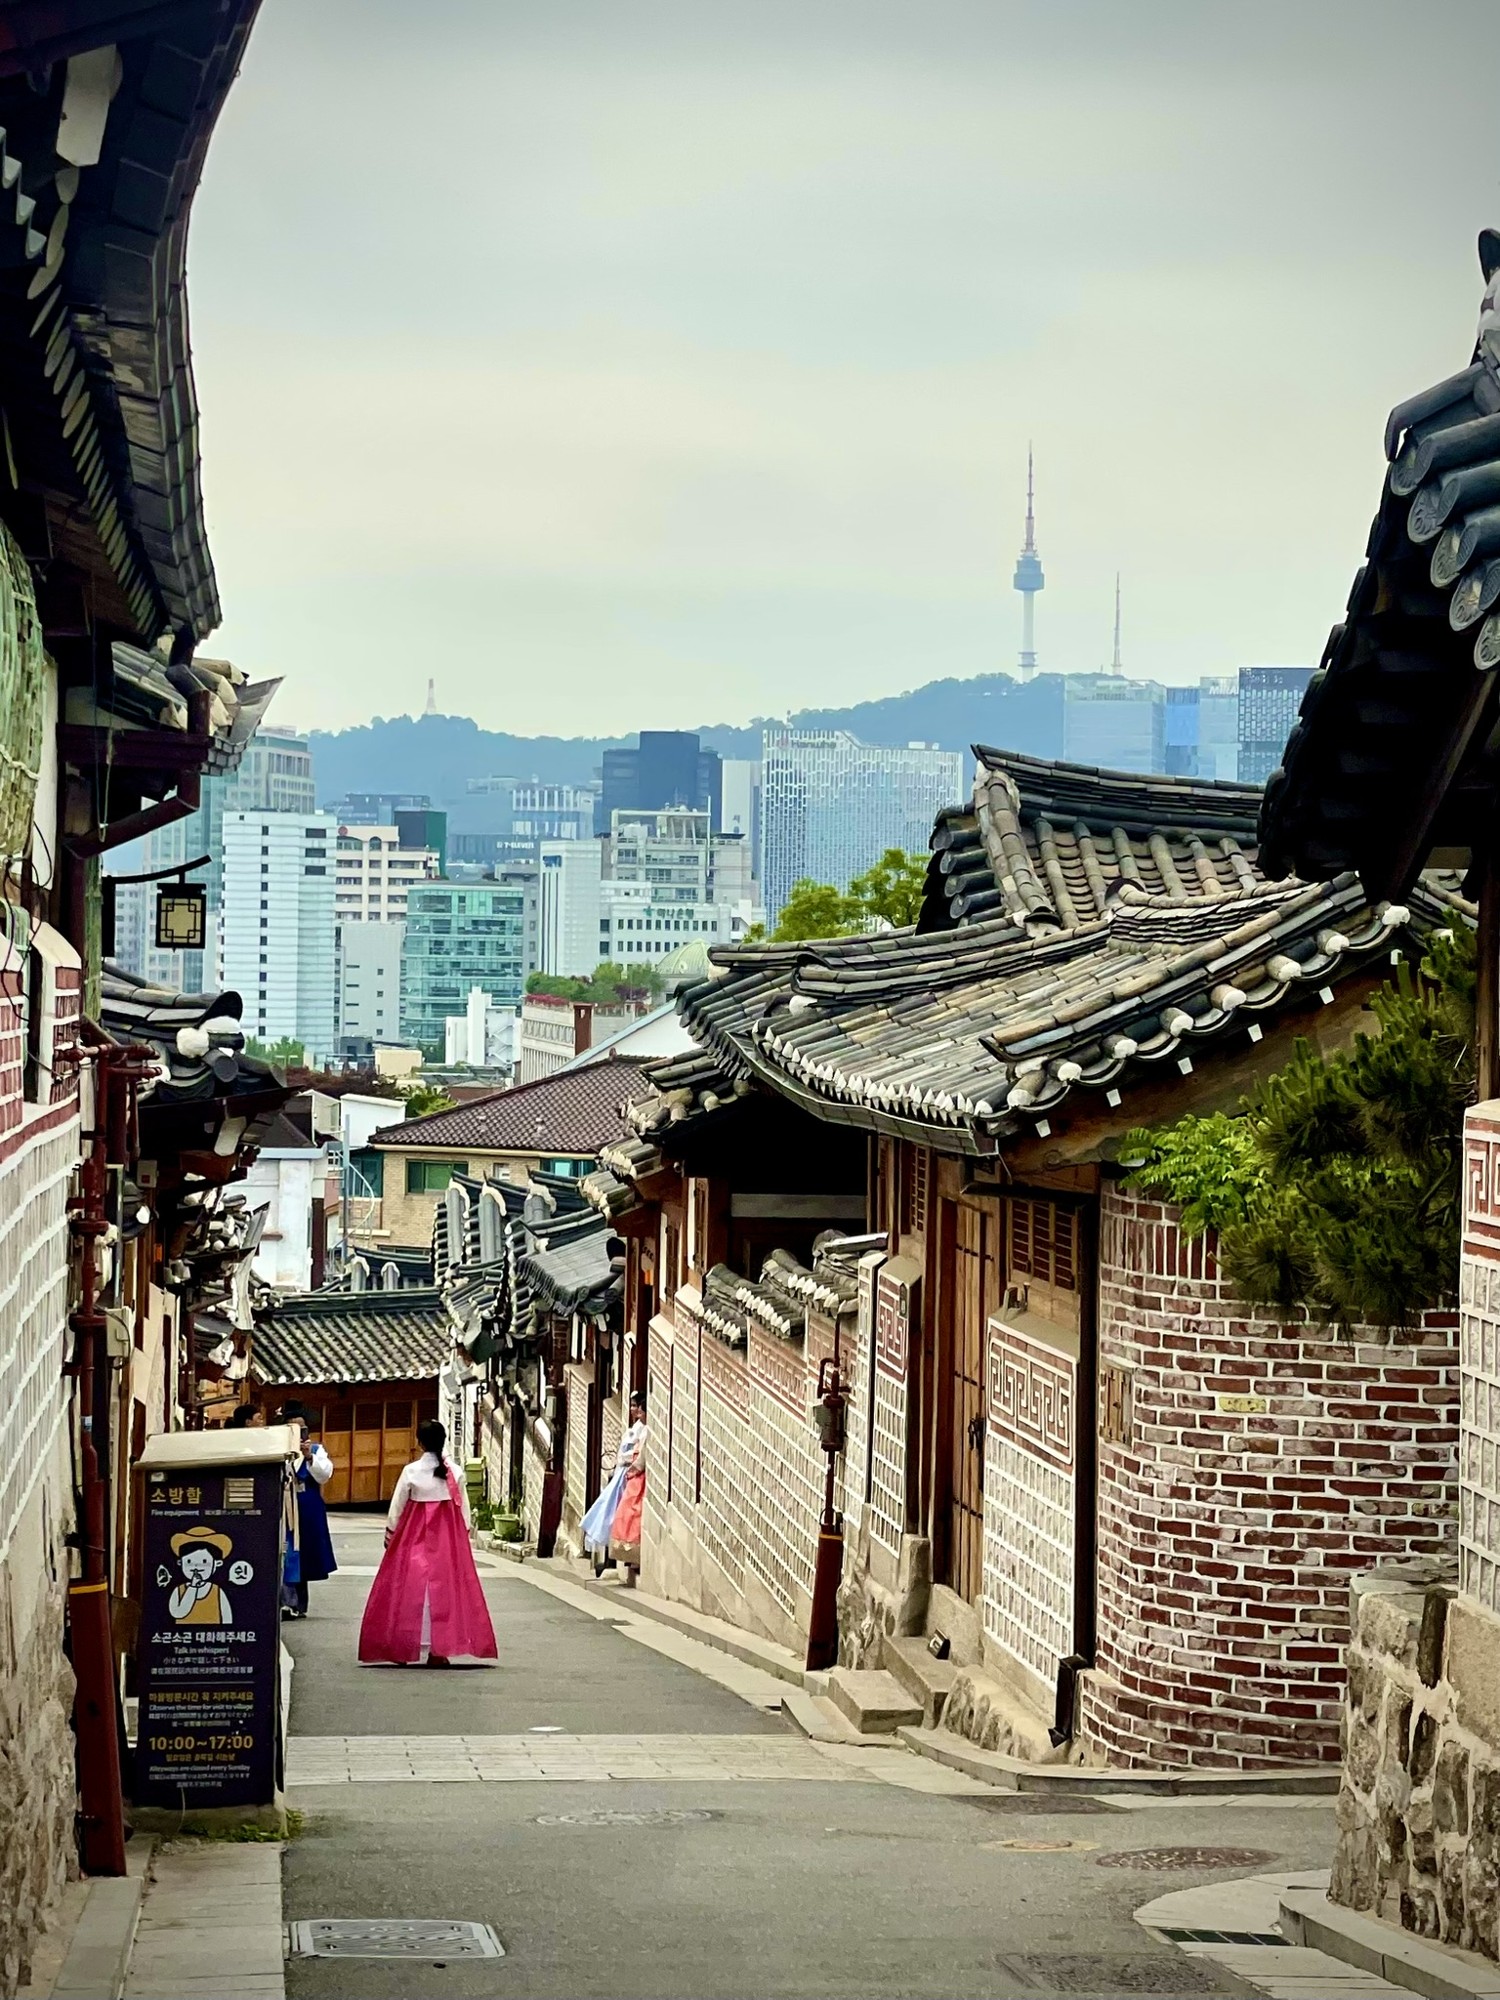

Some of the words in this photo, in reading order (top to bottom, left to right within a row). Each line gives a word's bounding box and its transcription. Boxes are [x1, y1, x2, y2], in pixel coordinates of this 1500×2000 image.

[791, 739, 837, 749] Hanwha
[150, 1487, 202, 1505] 소방함
[164, 1509, 199, 1517] equipment
[234, 1565, 248, 1580] 쉿
[151, 1631, 192, 1644] 소곤소곤
[195, 1631, 257, 1644] 대화해주세요
[174, 1646, 188, 1655] Talk
[189, 1646, 197, 1654] in
[149, 1692, 199, 1703] 마을방문시간
[213, 1691, 254, 1702] 지켜주세요
[149, 1735, 254, 1750] 10:00~17:00
